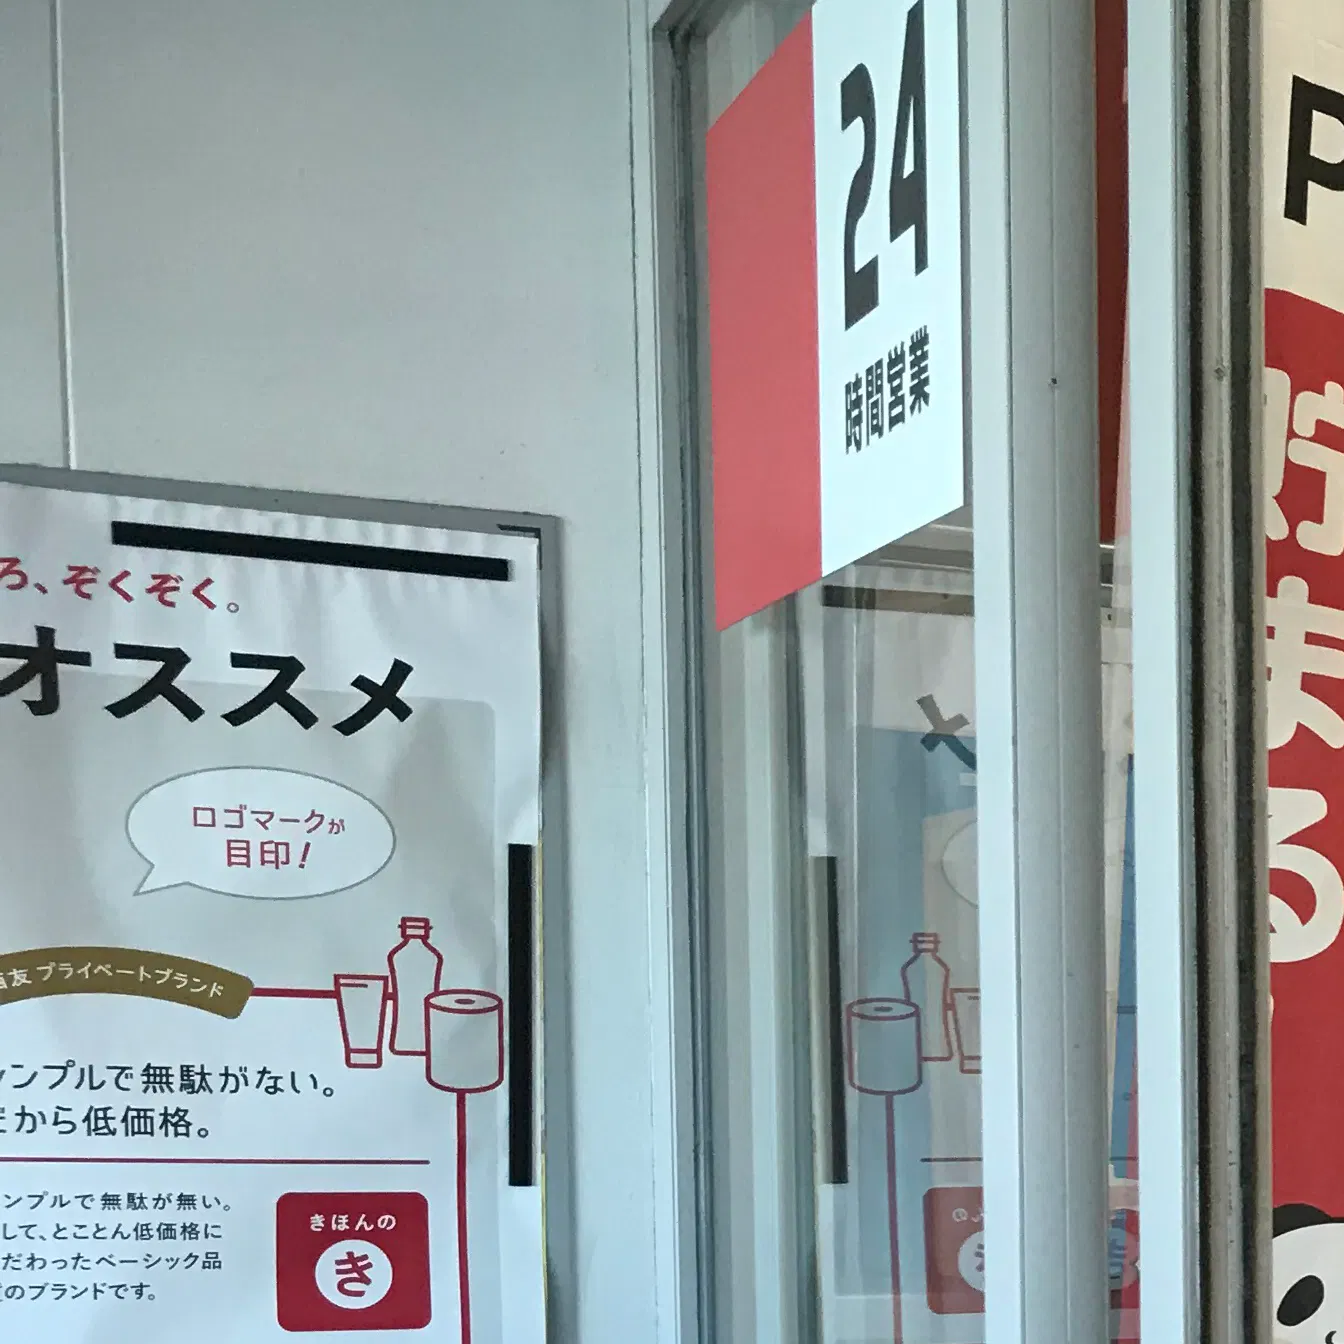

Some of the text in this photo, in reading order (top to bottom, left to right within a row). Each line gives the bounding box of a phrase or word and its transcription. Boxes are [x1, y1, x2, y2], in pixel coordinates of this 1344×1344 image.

[840, 1, 928, 331] 24
[845, 325, 930, 454] 時間営業
[0, 625, 414, 738] オススメ
[192, 804, 346, 836] ロゴマークが
[225, 839, 313, 870] 目印!
[0, 1060, 336, 1097] ンプルで無駄がない。
[309, 1212, 397, 1233] きほんの
[0, 1281, 156, 1304] のブランドです。
[333, 1251, 374, 1298] き
